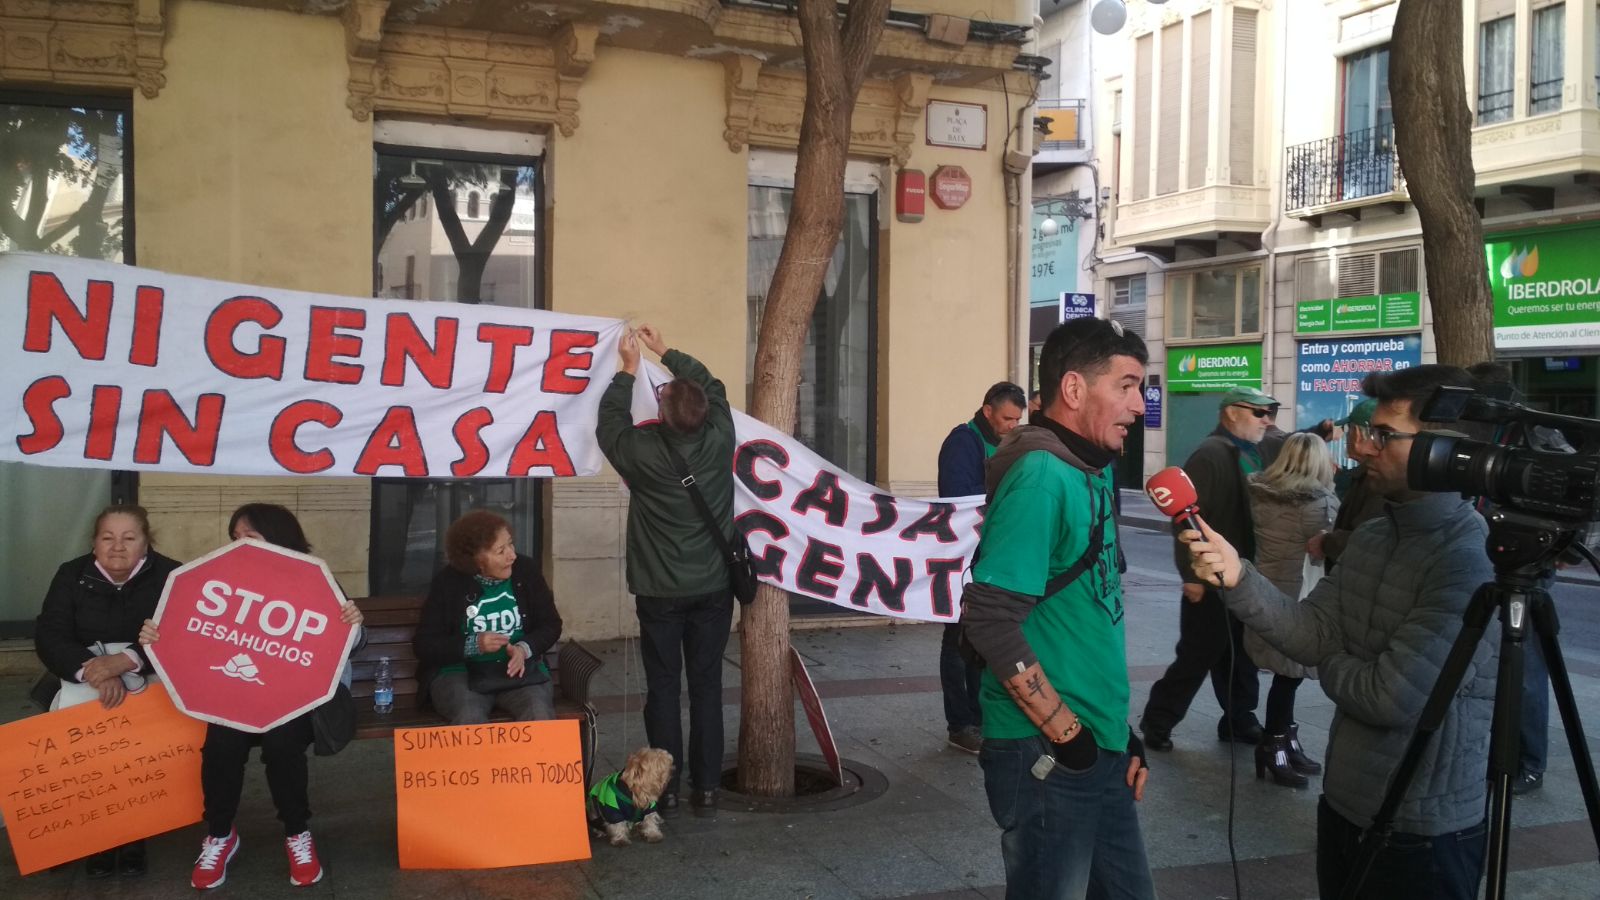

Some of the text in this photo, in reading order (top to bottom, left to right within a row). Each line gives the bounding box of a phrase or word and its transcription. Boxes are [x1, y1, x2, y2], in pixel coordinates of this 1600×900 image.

[947, 134, 967, 143] BAIX
[1032, 260, 1056, 278] 197€
[1065, 306, 1093, 314] CLINICA
[1508, 304, 1550, 316] Queremos
[1551, 303, 1564, 311] ser
[1566, 302, 1575, 311] tu
[22, 270, 601, 395] NI GENTE
[1496, 332, 1520, 341] Punto
[1520, 331, 1531, 340] de
[1532, 329, 1568, 340] Atención
[1569, 328, 1577, 338] al
[1301, 339, 1405, 356] Entra y comprueba
[1197, 355, 1249, 369] IBERDROLA
[1301, 362, 1330, 373] como
[1331, 357, 1393, 373] AHORRAR
[1301, 378, 1362, 392] tu FACTUR
[16, 374, 579, 478] SIN CASA
[195, 579, 329, 642] STOP
[186, 617, 314, 667] DESAHUCIOS
[27, 715, 132, 759] YA BASTA
[8, 770, 104, 802] TENEMOS
[114, 762, 129, 775] LA
[18, 763, 49, 783] DE
[129, 769, 166, 785] MAS
[491, 766, 532, 785] PARA
[536, 760, 583, 786] TODOS
[28, 789, 168, 840] CARA DE EUROPA
